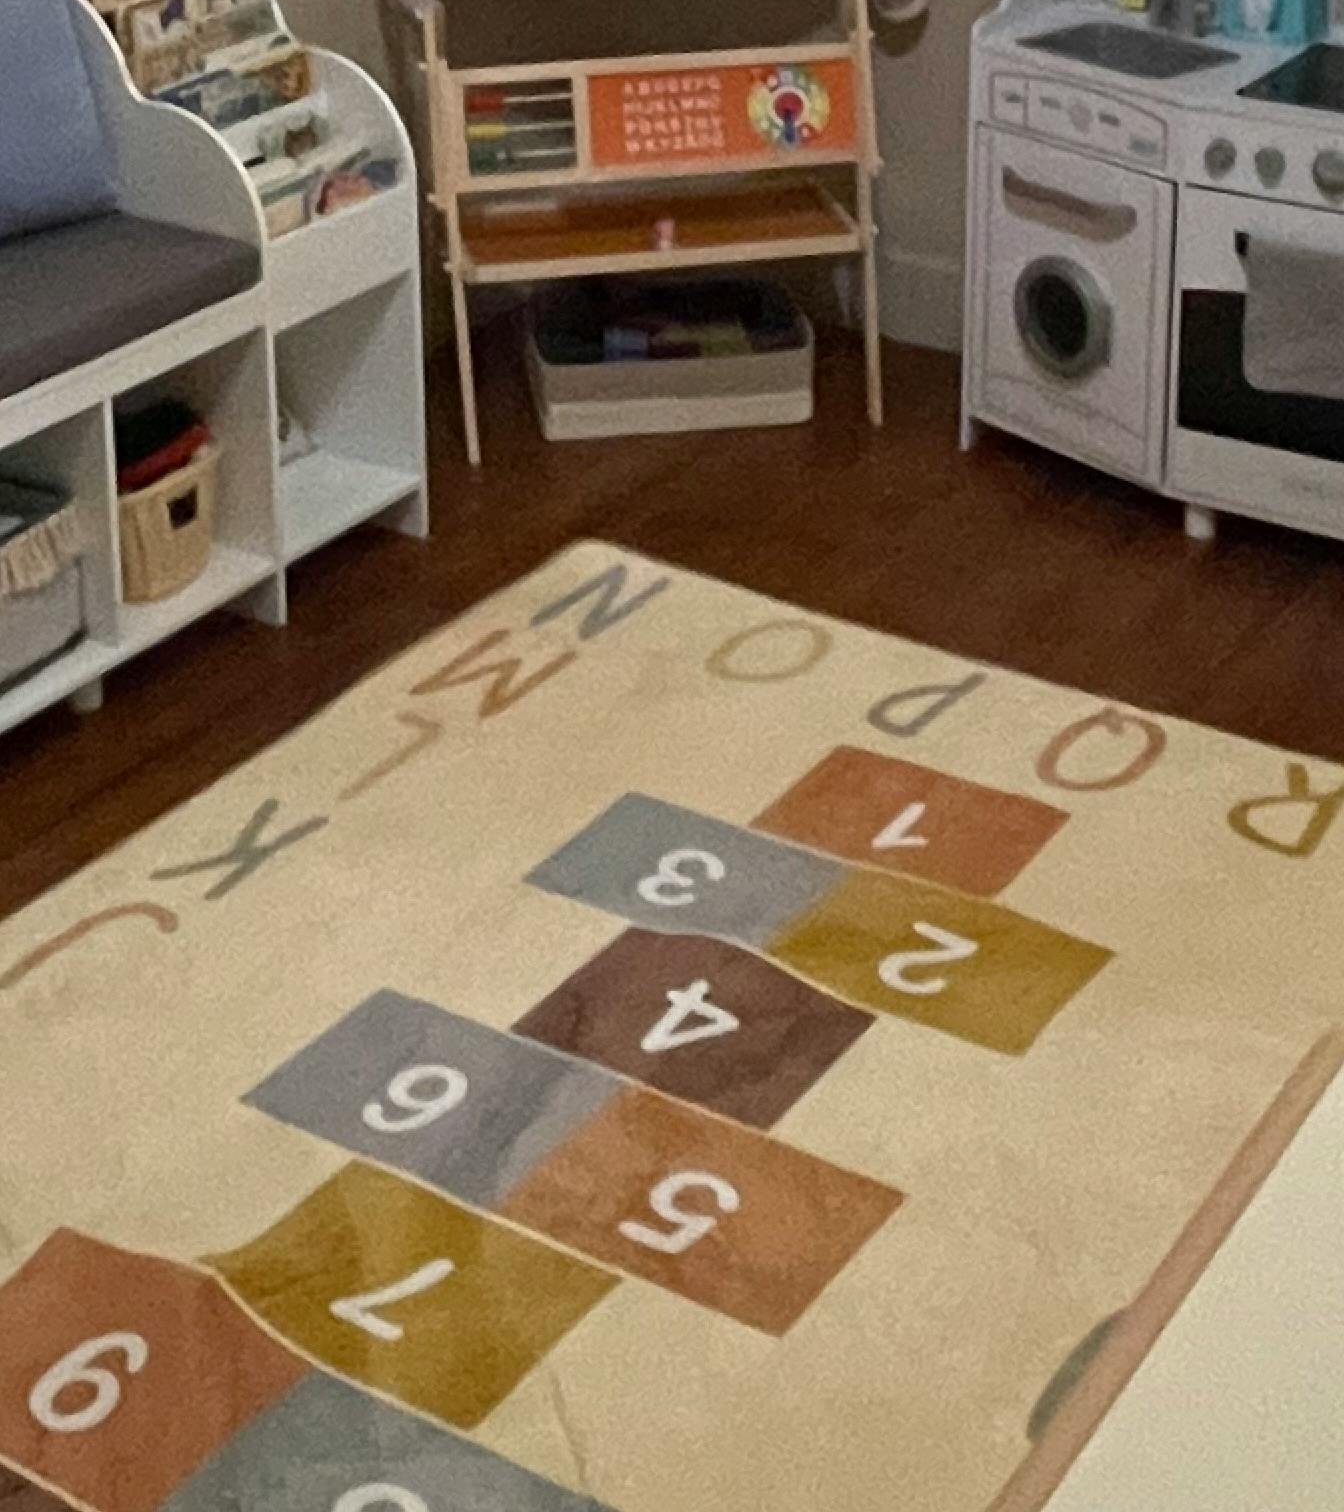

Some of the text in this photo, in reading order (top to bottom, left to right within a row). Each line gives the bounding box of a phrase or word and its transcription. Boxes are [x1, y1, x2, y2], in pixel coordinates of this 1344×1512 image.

[529, 564, 670, 641] N
[408, 628, 579, 722] M
[703, 619, 834, 683] O
[865, 670, 988, 738] P
[338, 710, 444, 801] L
[1034, 707, 1167, 792] Q
[149, 797, 330, 901] K
[871, 801, 928, 852] 1
[636, 848, 725, 906] 3
[876, 921, 979, 996] 2
[639, 978, 741, 1053] 4
[361, 1063, 469, 1133] 6
[617, 1169, 741, 1255] 5
[328, 1257, 456, 1342] 7
[28, 1331, 149, 1434] 9
